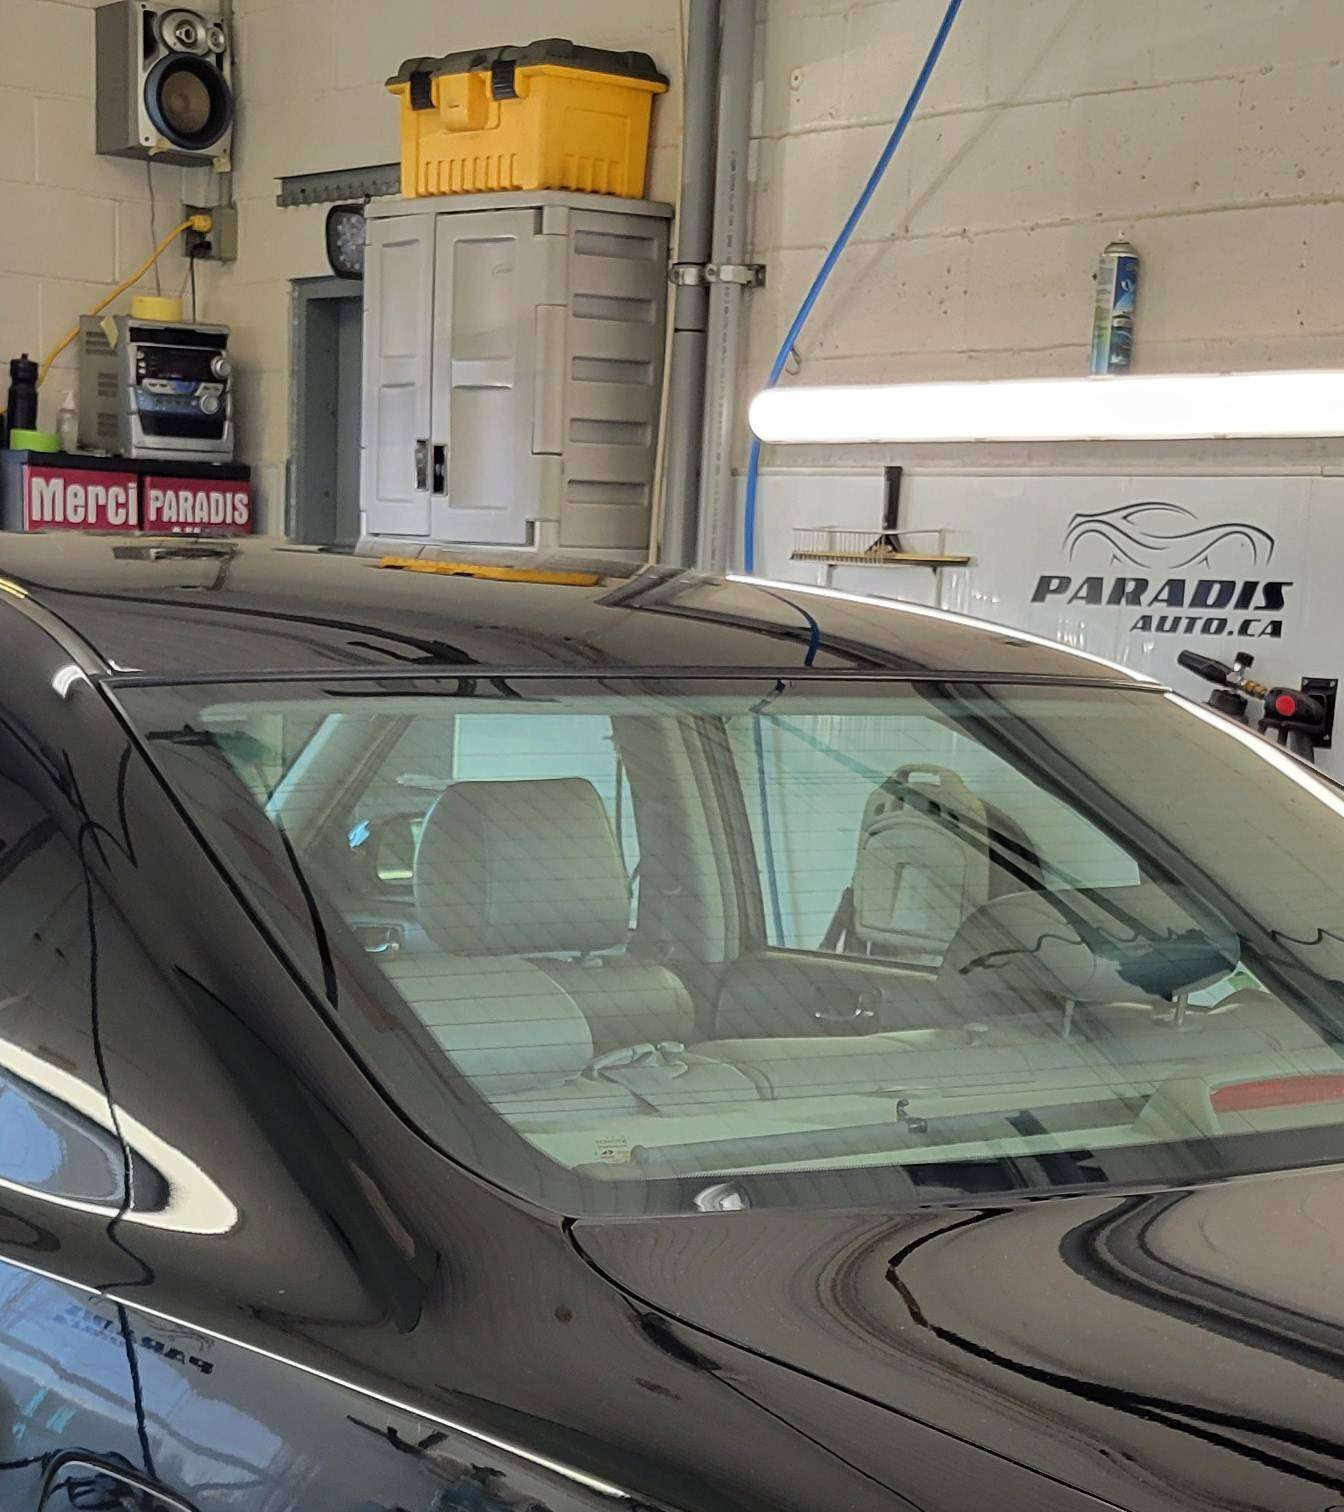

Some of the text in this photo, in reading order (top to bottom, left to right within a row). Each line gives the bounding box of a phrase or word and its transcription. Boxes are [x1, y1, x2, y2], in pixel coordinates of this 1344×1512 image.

[31, 476, 138, 527] Merci
[149, 489, 250, 525] PARADIS
[1030, 575, 1294, 612] PARADIS
[1129, 614, 1284, 639] AUTO.CA
